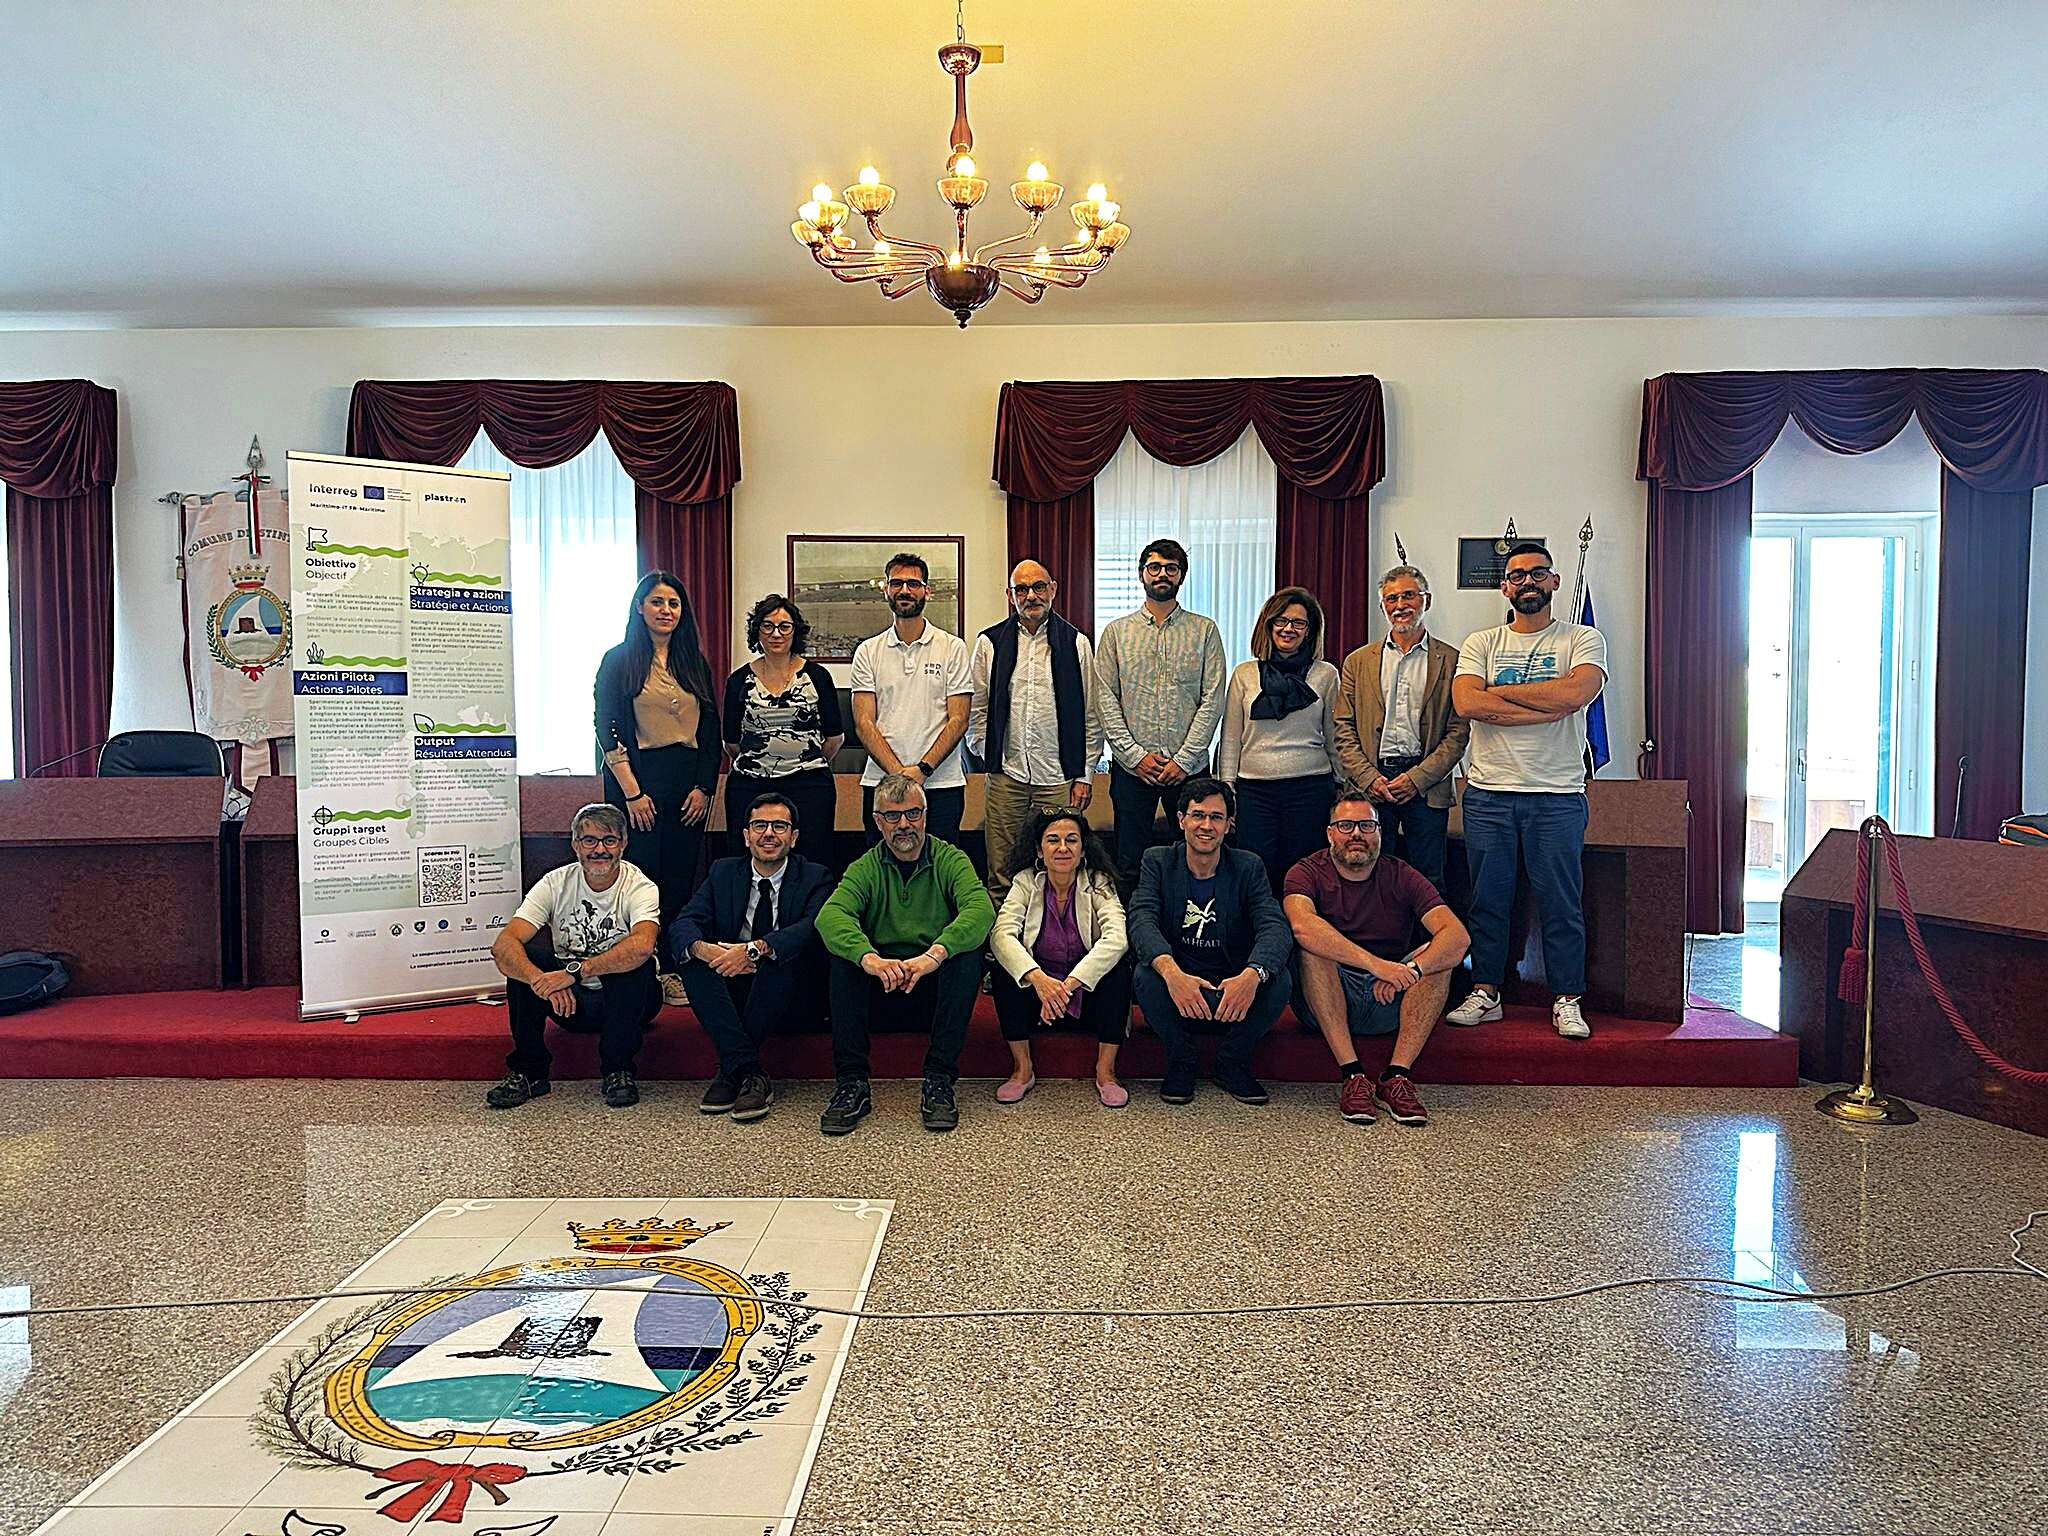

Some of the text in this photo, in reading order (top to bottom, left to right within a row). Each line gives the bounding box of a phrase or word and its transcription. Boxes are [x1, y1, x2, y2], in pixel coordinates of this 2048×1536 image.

[309, 483, 358, 498] Interreg
[187, 532, 234, 557] COMUNE
[305, 557, 357, 569] Obiettivo
[305, 570, 347, 581] Objectif
[410, 587, 461, 599] Strategia
[473, 589, 504, 600] azioni
[410, 599, 458, 610] Stratégie
[460, 602, 470, 610] et
[472, 602, 509, 612] Actions
[300, 671, 375, 682] Azioni Pilota
[300, 684, 383, 694] Actions Pilotes
[415, 737, 457, 748] Output
[415, 748, 512, 759] Résultats Attendus
[313, 824, 386, 836] Gruppi target
[313, 836, 390, 848] Groupes Cibles
